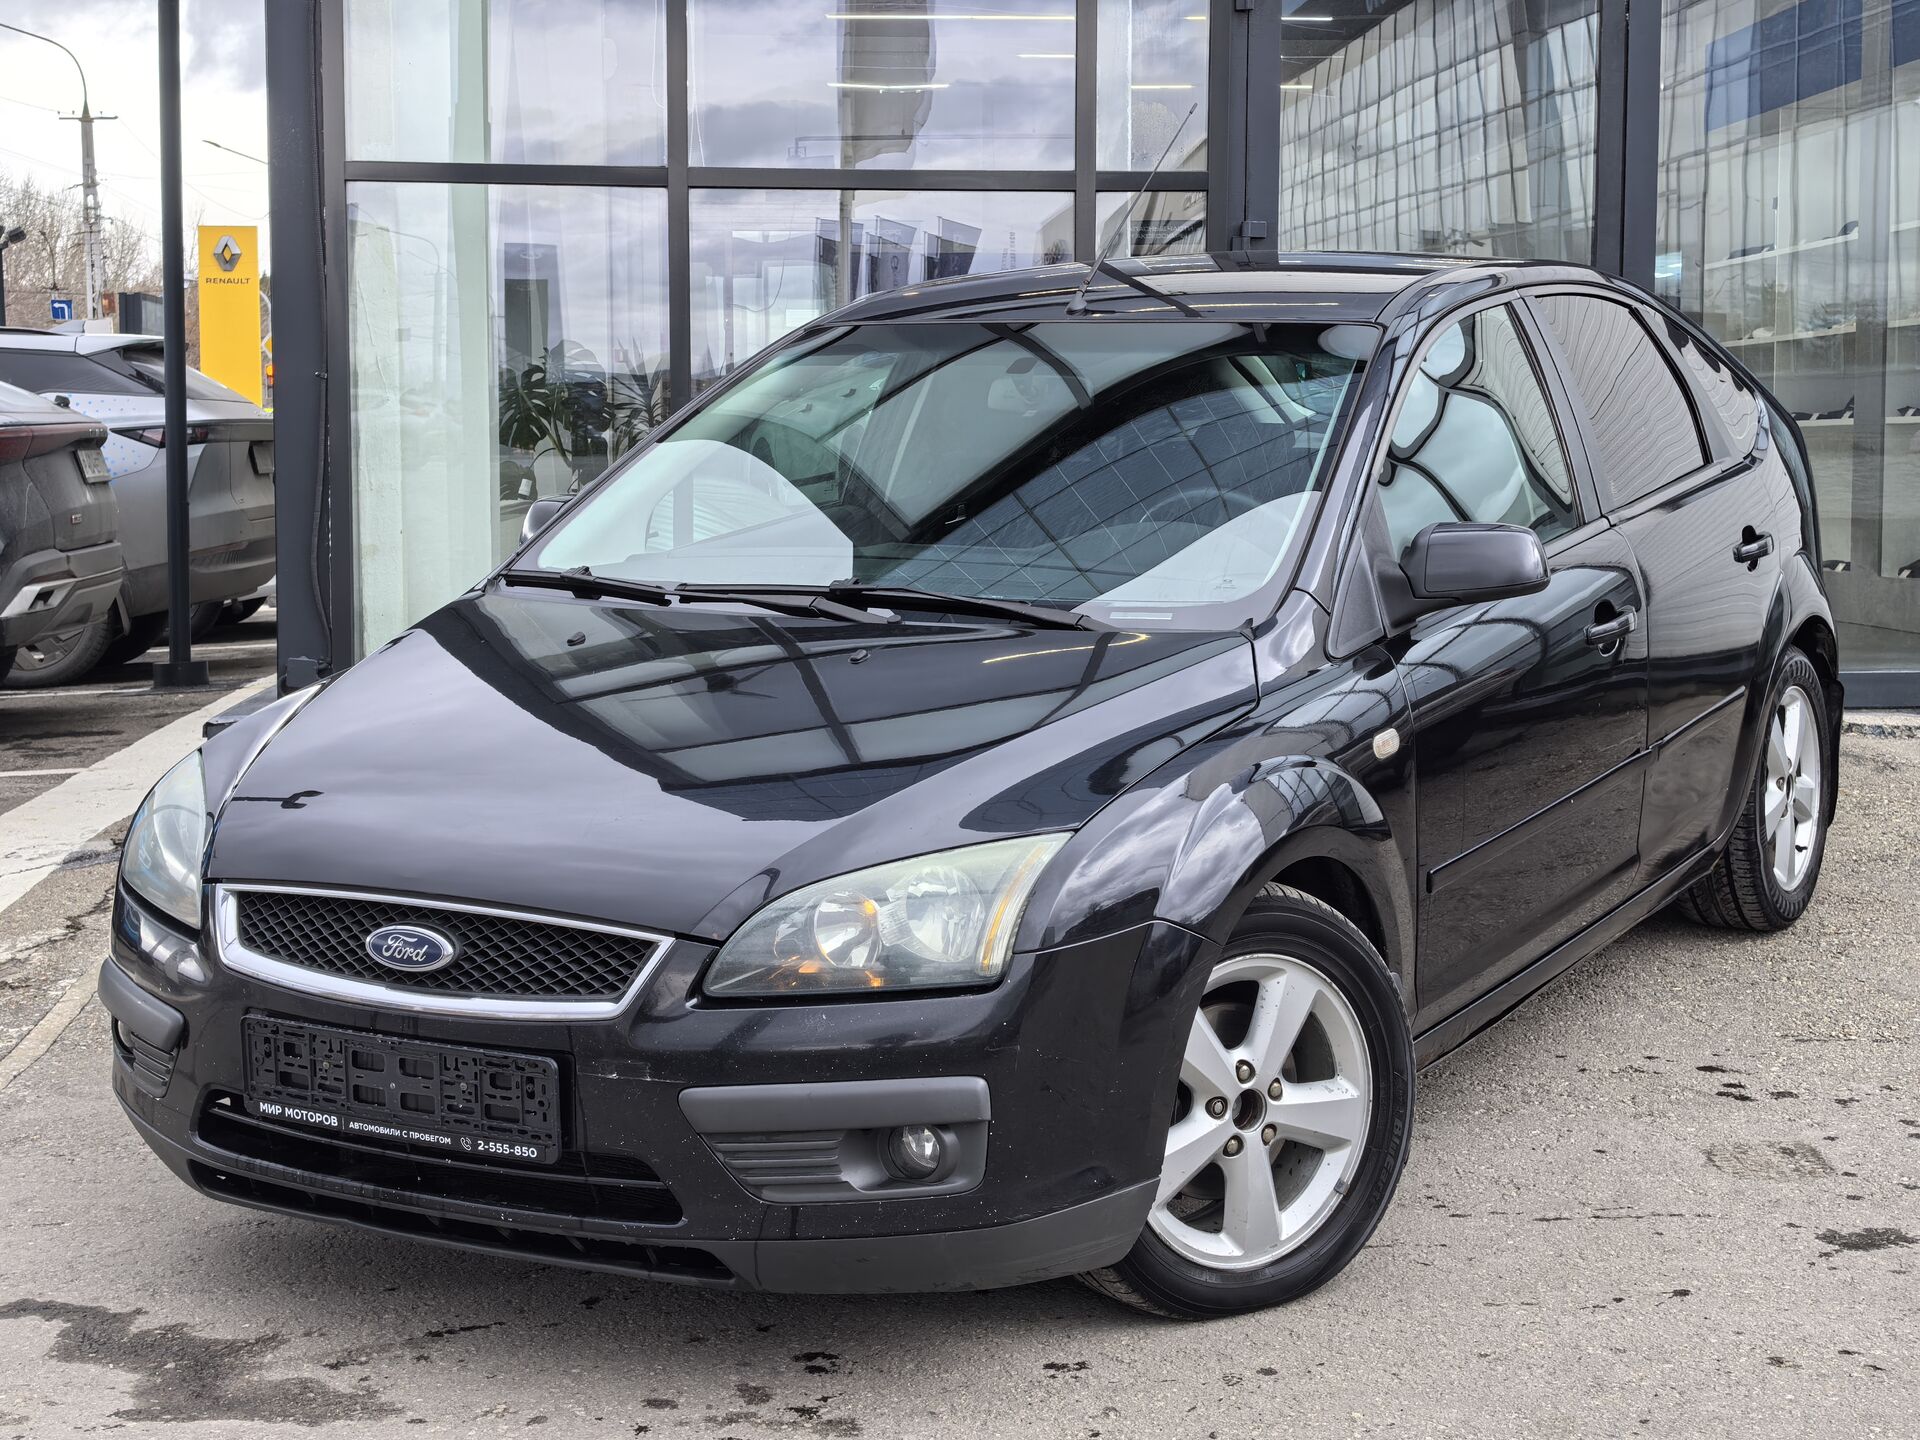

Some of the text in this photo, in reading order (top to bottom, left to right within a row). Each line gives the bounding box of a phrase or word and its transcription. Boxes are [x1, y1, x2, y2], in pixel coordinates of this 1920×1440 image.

[205, 277, 251, 285] RENAULT
[382, 934, 429, 962] Ford
[259, 1102, 538, 1158] МИР МОТОРОВ АВТОМОБИЛИ С ПРОБЕГОМ 2-555-850
